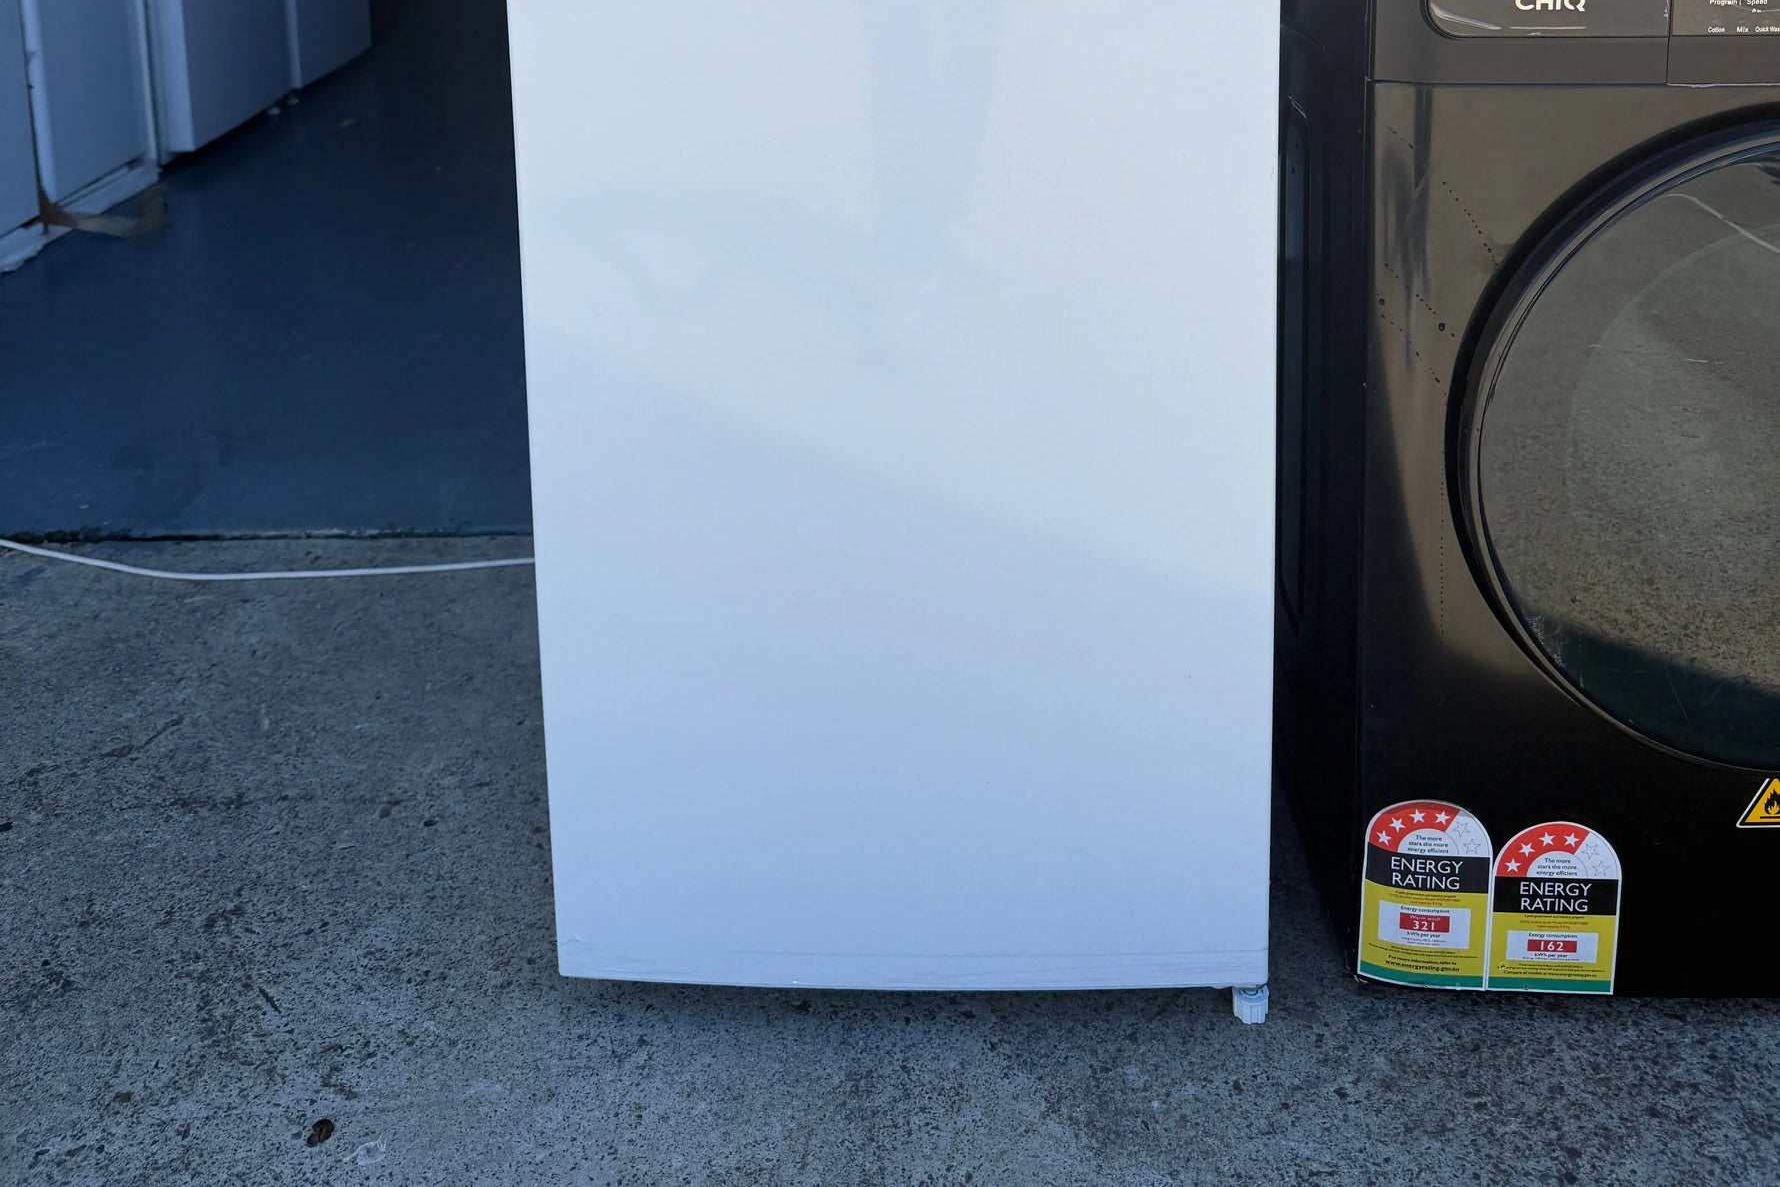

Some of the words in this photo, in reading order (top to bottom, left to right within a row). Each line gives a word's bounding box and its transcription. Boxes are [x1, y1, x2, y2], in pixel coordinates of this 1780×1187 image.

[1391, 856, 1463, 874] ENERGY
[1392, 872, 1460, 890] RATING
[1520, 882, 1592, 896] ENERGY
[1521, 898, 1588, 912] RATING
[1413, 921, 1435, 931] 321
[1541, 941, 1564, 951] 162
